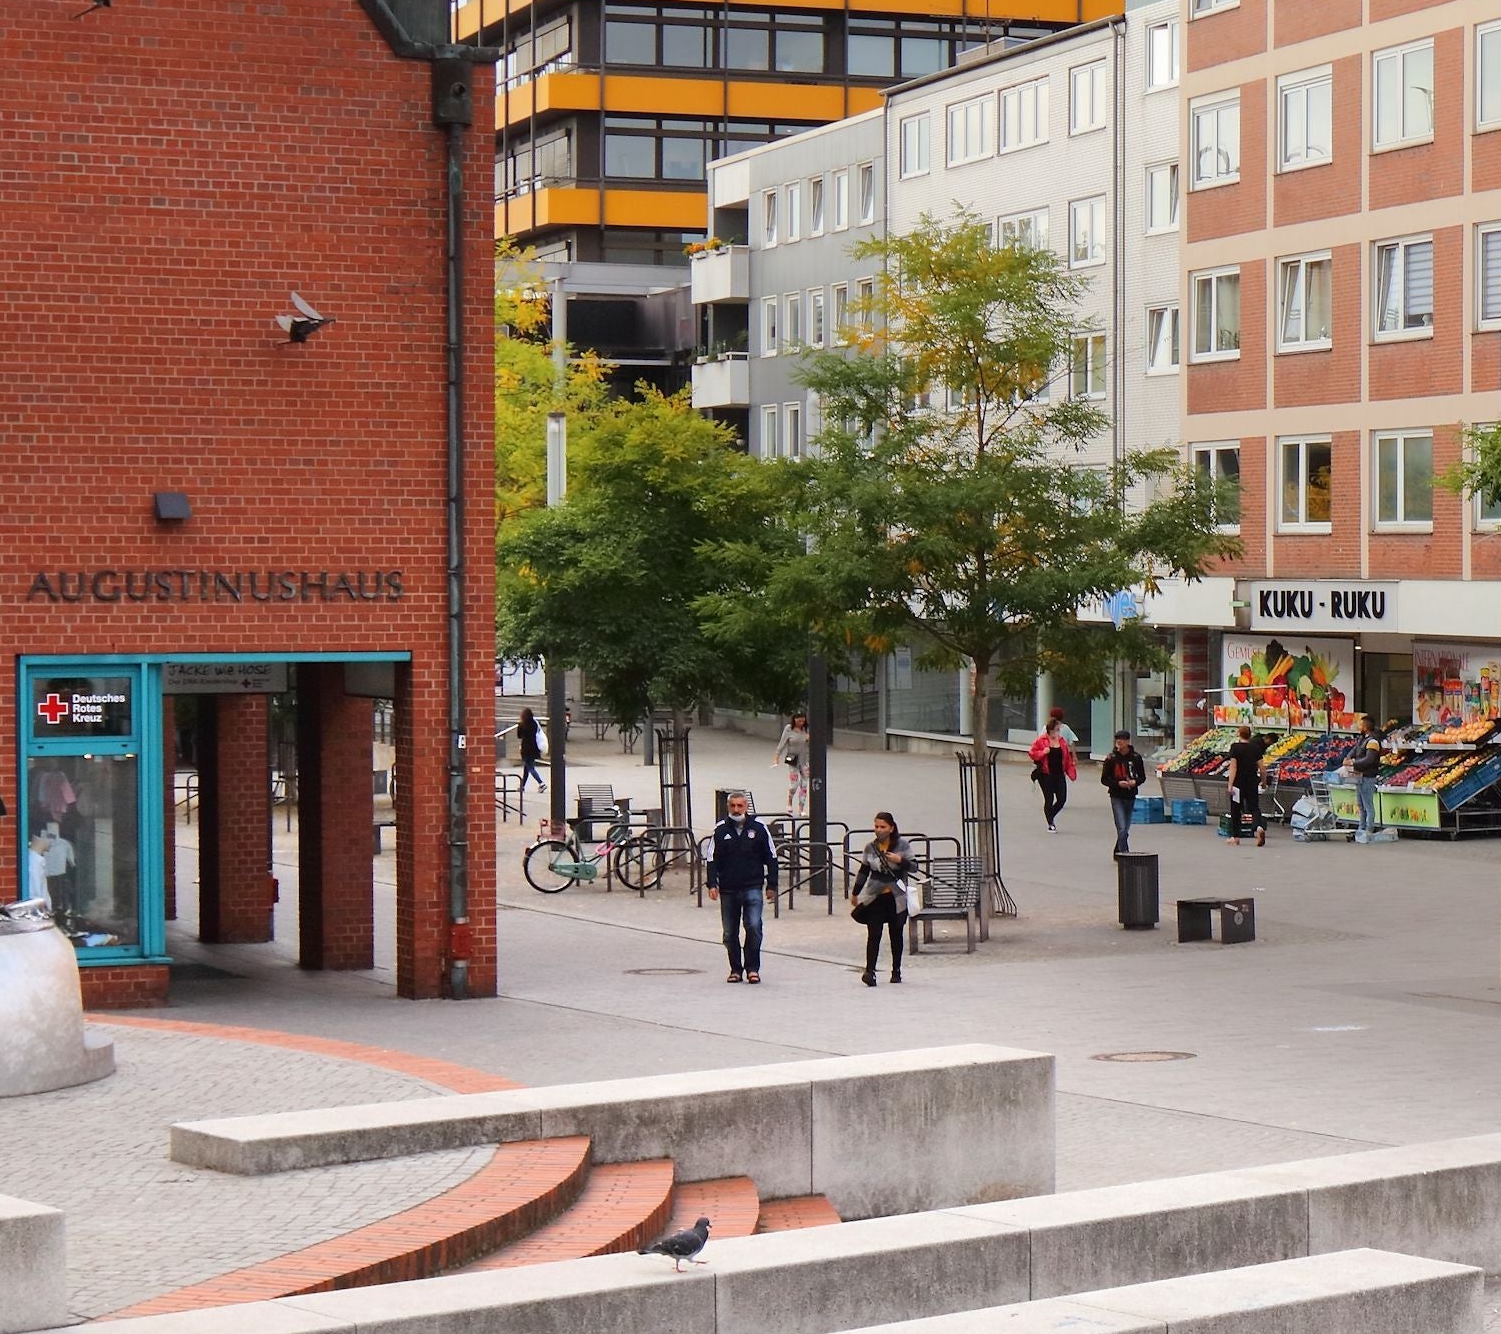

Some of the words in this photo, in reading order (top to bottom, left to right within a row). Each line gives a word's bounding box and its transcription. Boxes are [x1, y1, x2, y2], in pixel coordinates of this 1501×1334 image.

[26, 569, 403, 602] AUGUSTINUSHAUS
[1260, 590, 1313, 618] KUKU
[1331, 591, 1385, 619] RUKU
[72, 694, 126, 704] Deutsches
[72, 704, 102, 713] Rotes
[72, 713, 102, 723] Kreuz
